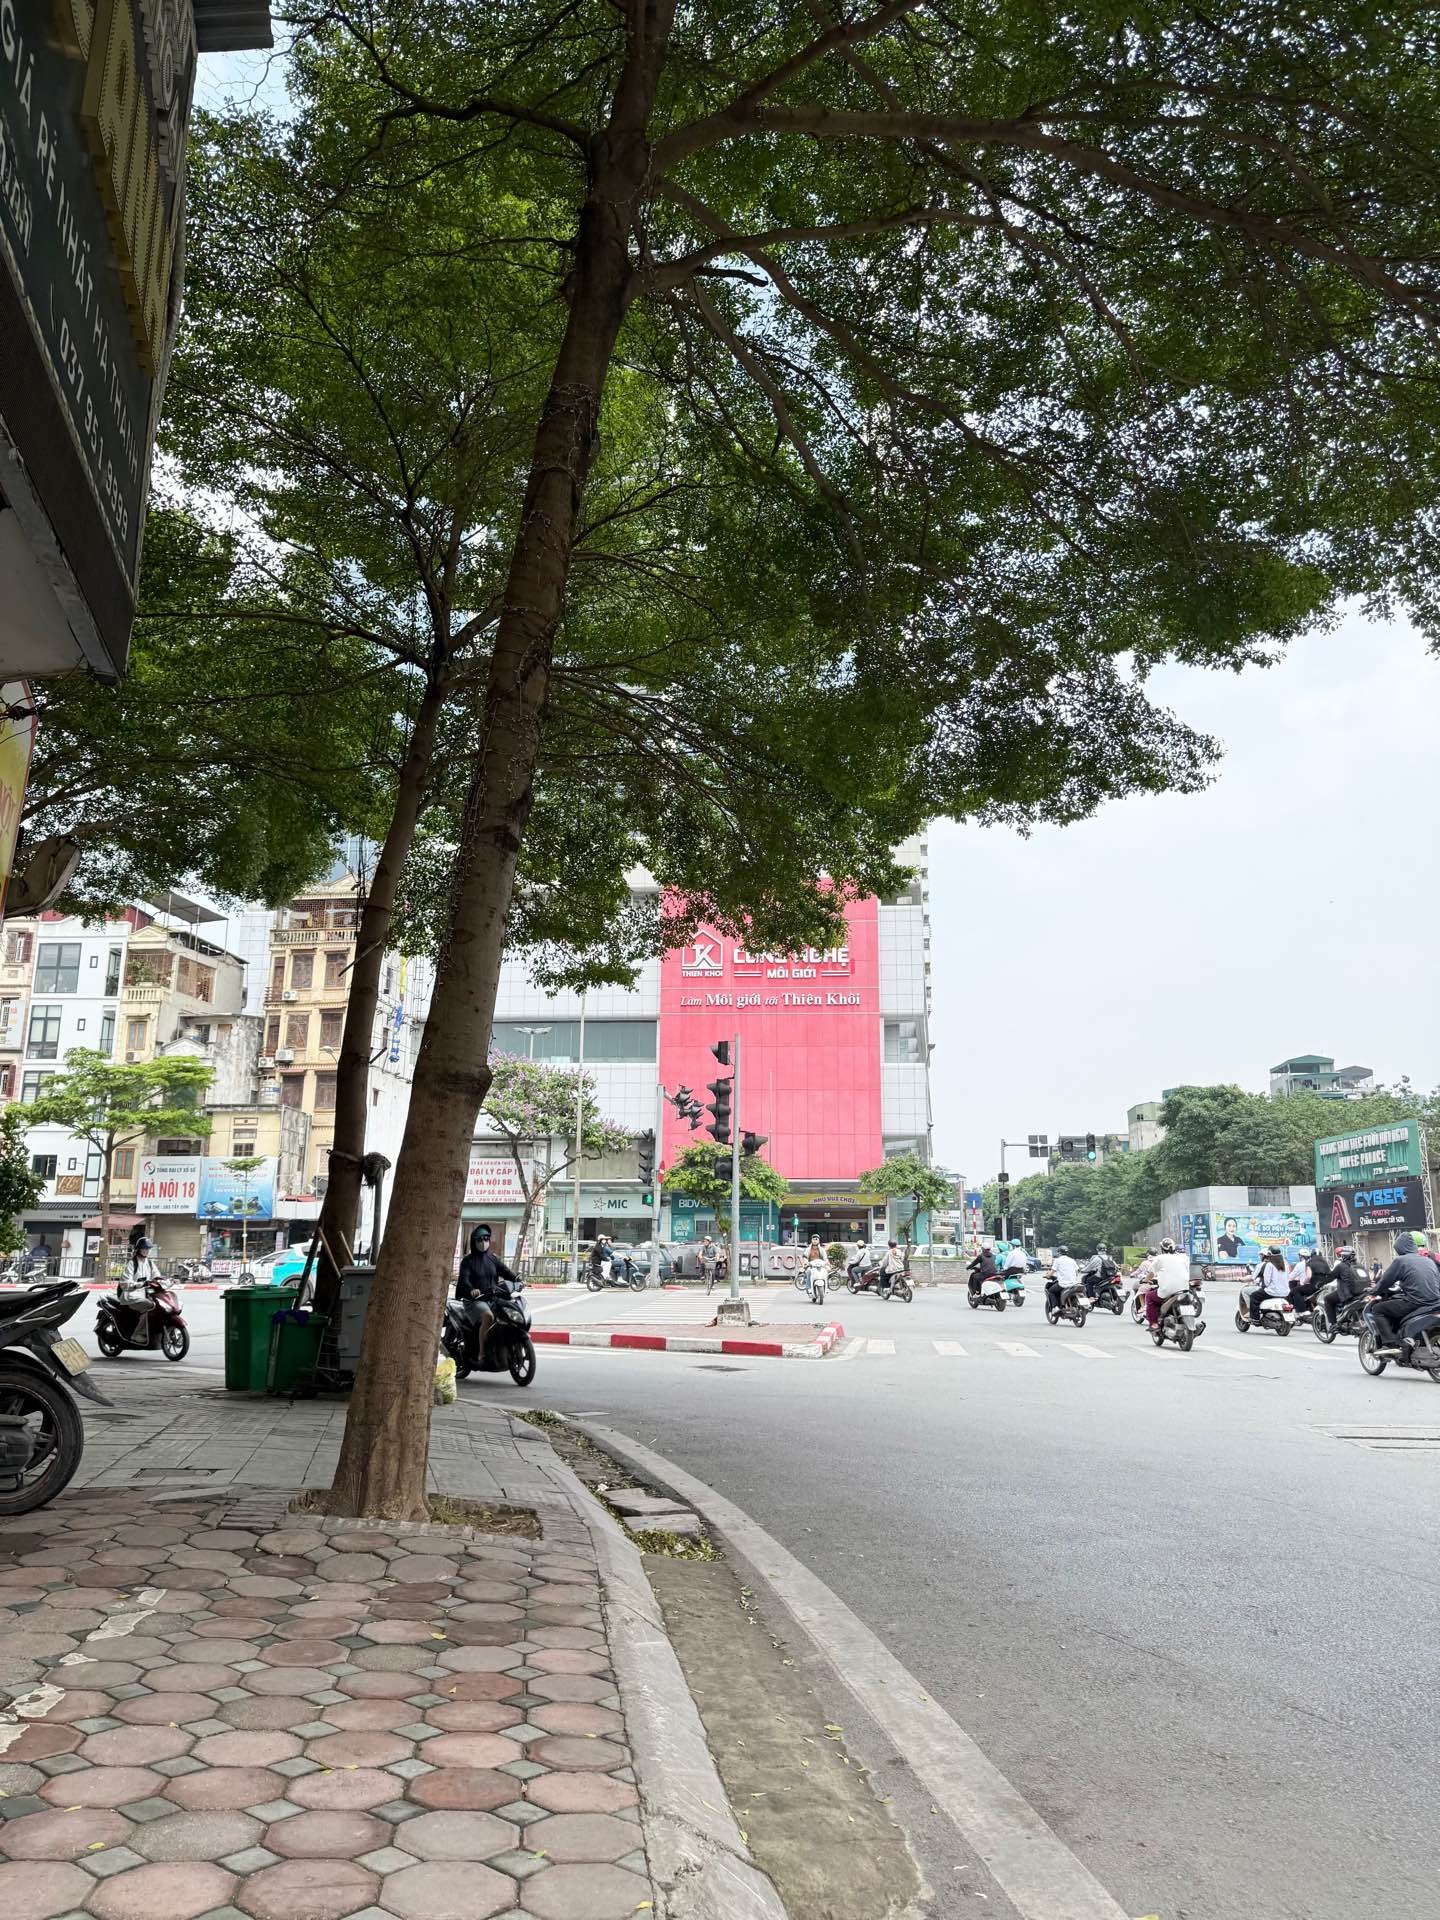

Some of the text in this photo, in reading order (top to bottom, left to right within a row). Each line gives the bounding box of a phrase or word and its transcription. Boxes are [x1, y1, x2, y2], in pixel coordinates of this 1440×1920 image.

[0, 0, 35, 128] GIÁ
[57, 180, 94, 319] NHẤT
[60, 317, 129, 543] 037 951 9999
[766, 966, 817, 979] MÔI GIỚI
[705, 992, 733, 1006] Môi
[736, 991, 761, 1008] giới
[781, 992, 822, 1006] Thiên
[825, 991, 861, 1006] Khôi
[141, 1178, 196, 1202] HÀ NỘI 18
[1354, 1187, 1406, 1208] CYBER
[607, 1199, 628, 1209] MIC
[678, 1199, 701, 1208] BIDV
